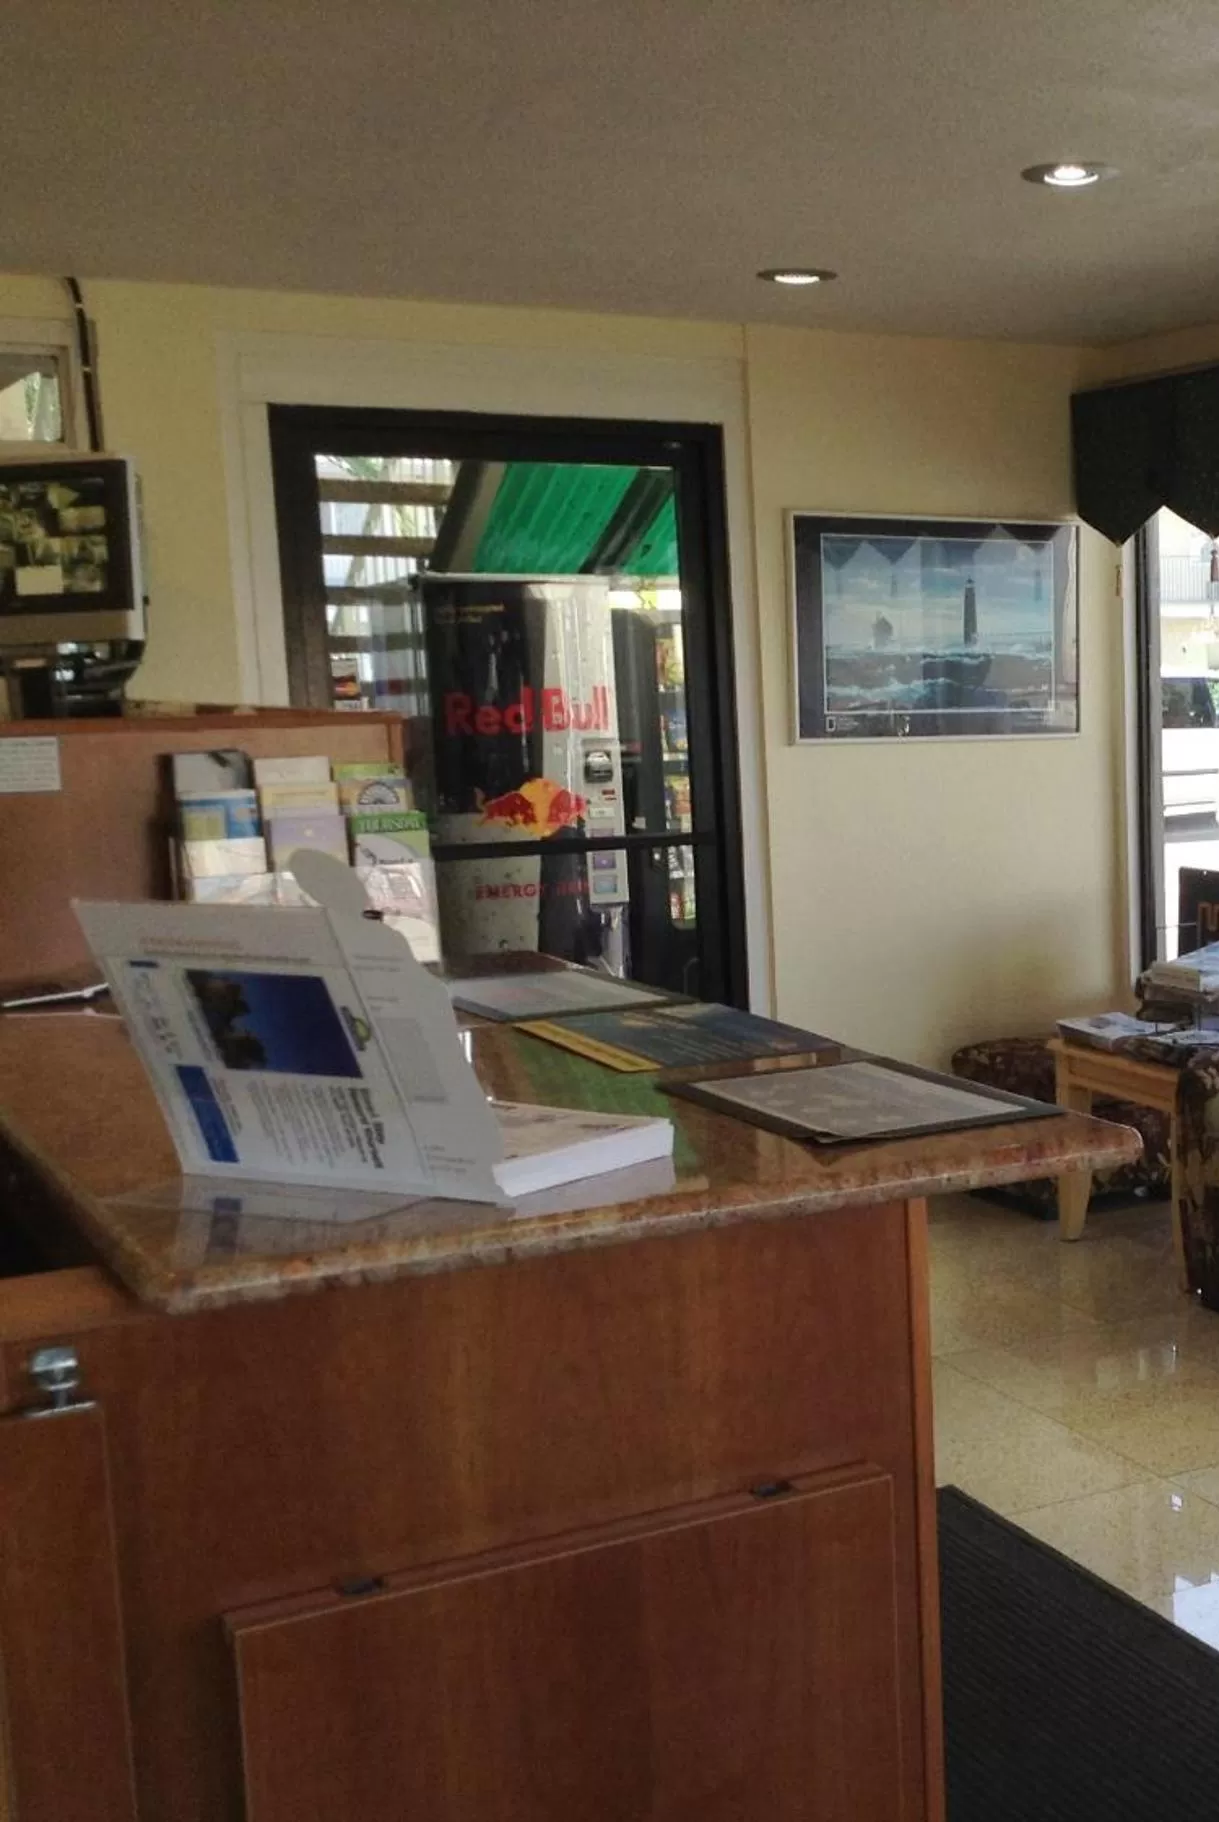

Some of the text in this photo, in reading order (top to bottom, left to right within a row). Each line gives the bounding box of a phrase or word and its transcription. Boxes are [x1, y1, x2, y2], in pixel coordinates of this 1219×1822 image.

[444, 679, 609, 736] Red Bull
[475, 881, 545, 901] ENERGY
